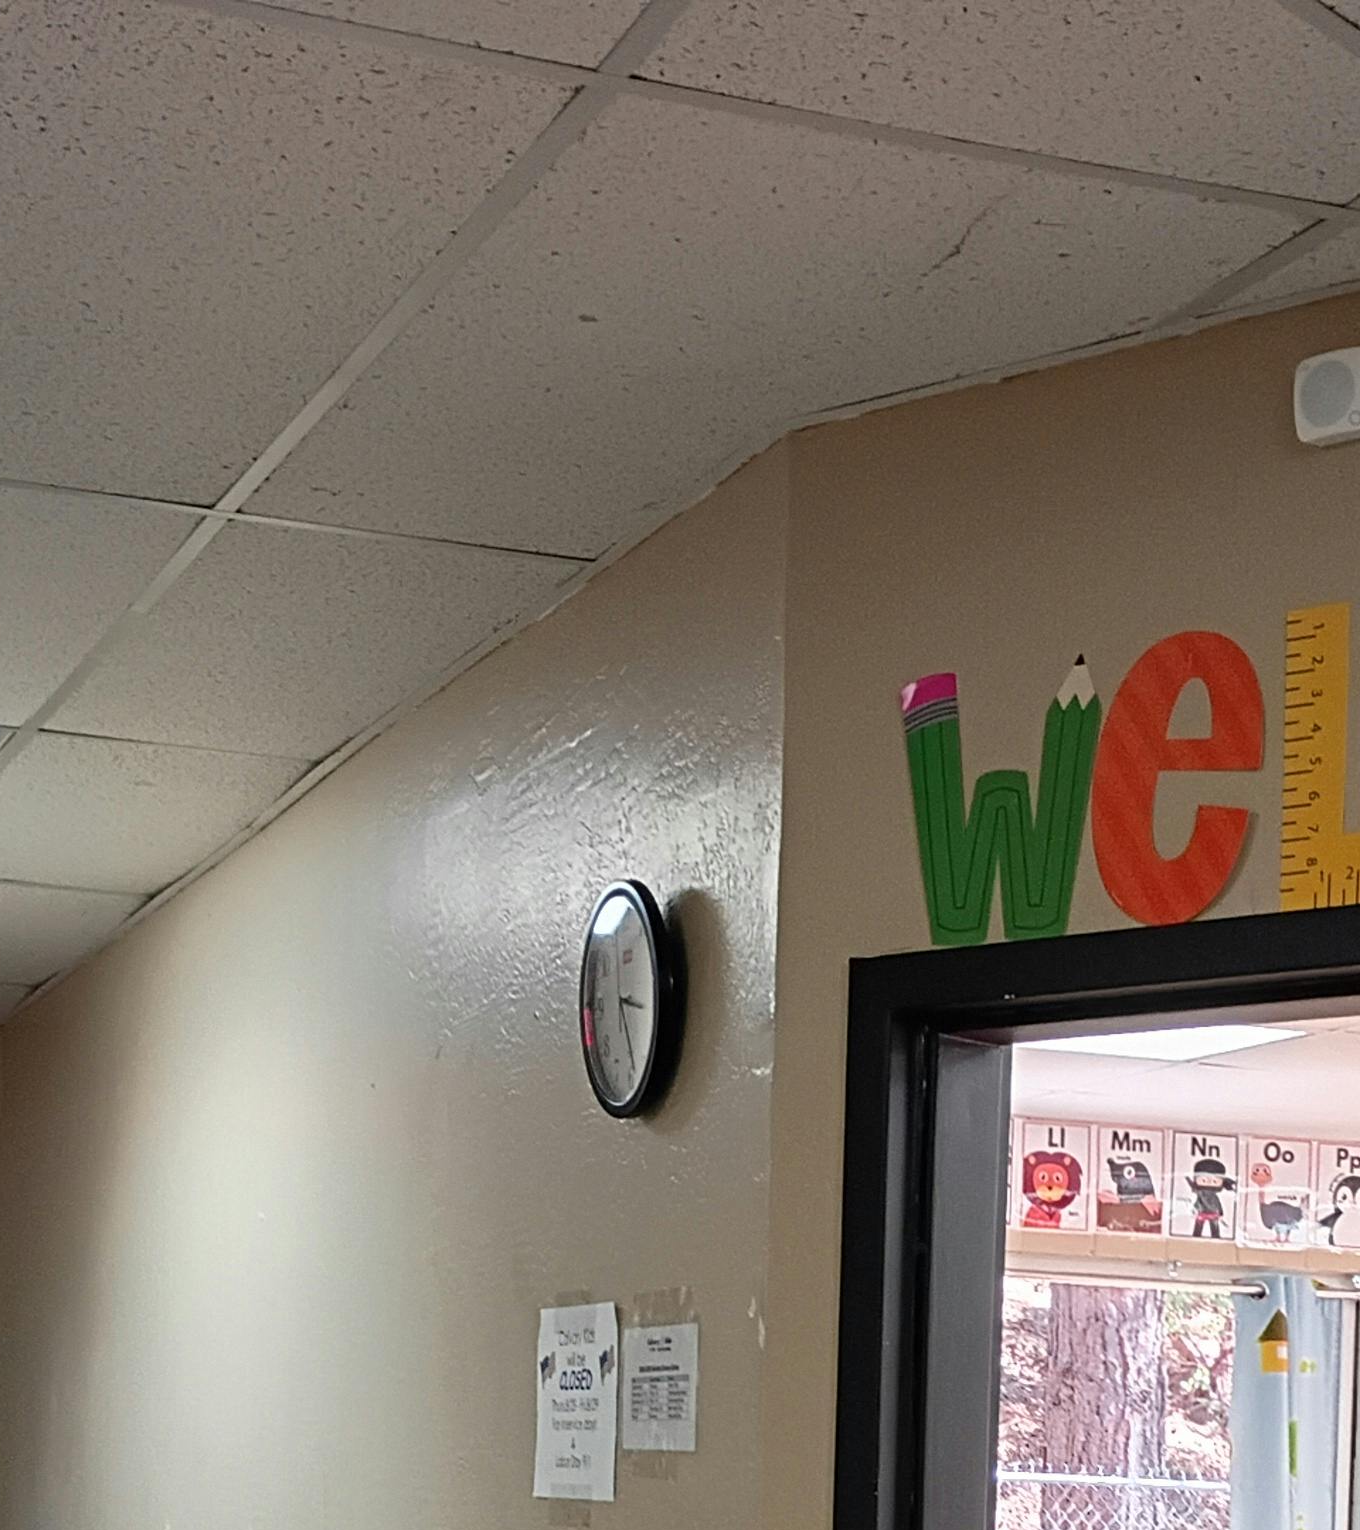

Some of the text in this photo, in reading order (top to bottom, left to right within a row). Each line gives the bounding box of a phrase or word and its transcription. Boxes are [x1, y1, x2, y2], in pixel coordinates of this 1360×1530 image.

[1311, 655, 1324, 666] 2
[1311, 688, 1323, 698] 3
[1310, 723, 1322, 733] 4
[1310, 756, 1322, 766] 5
[1308, 790, 1320, 801] 6
[1307, 824, 1319, 833] 7
[1306, 856, 1318, 867] 8
[1345, 866, 1354, 880] 2
[1111, 1131, 1151, 1154] Mm
[1191, 1137, 1221, 1158] Nn
[1264, 1142, 1294, 1164] Oo
[560, 1368, 593, 1391] CLOSED
